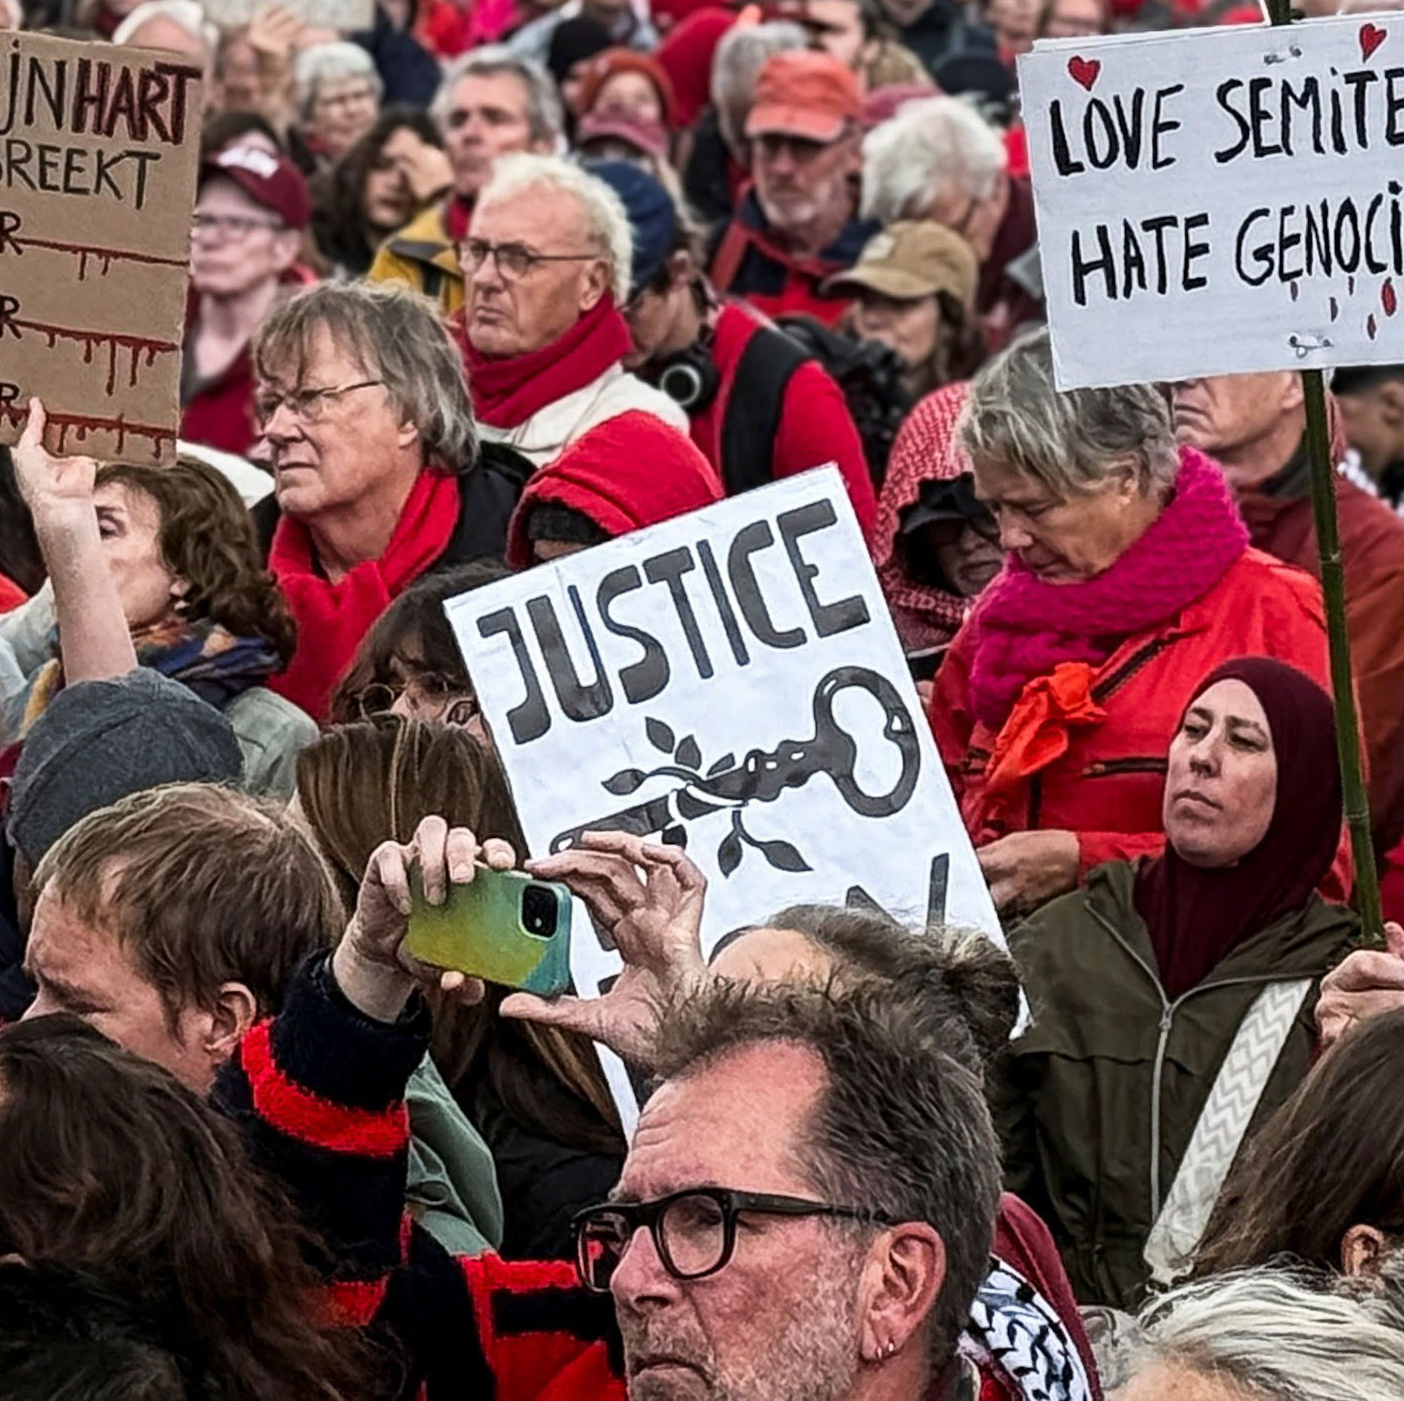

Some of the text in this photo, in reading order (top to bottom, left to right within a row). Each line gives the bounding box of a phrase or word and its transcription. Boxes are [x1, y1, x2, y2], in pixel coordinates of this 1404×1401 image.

[70, 56, 203, 146] HART
[1049, 83, 1185, 177] LOVE
[1070, 212, 1210, 307] HATE
[475, 497, 873, 746] JUSTICE
